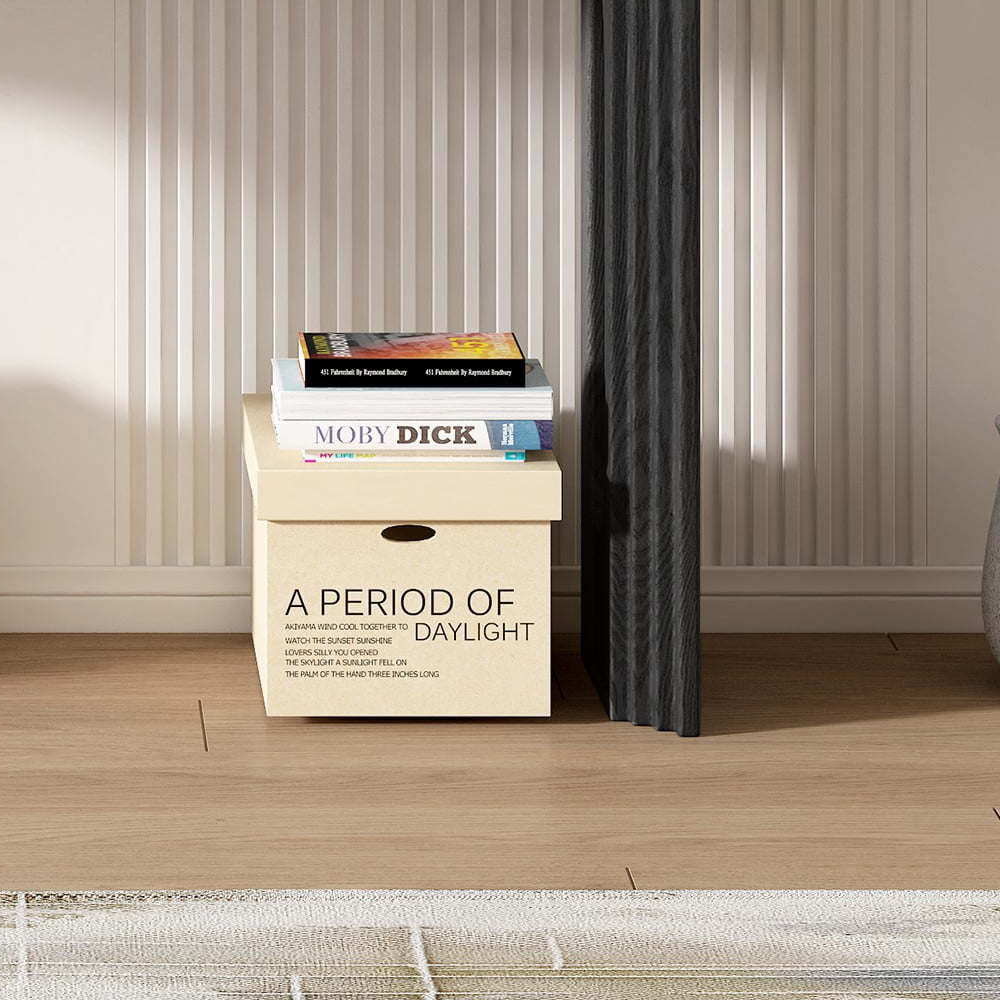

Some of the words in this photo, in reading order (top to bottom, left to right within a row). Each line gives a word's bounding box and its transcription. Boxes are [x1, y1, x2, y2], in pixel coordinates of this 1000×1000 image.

[320, 368, 330, 376] 451
[330, 368, 355, 376] Fahrenheit
[363, 368, 386, 377] Raymond
[386, 368, 408, 377] Bradbury
[425, 368, 434, 376] 451
[435, 368, 460, 376] Fahrenheit
[468, 368, 490, 377] Raymond
[491, 368, 512, 377] Bradbury
[314, 425, 391, 445] MOBY
[396, 425, 477, 445] DICK
[285, 588, 309, 616] A
[320, 588, 454, 616] PERIOD
[467, 588, 515, 616] OF
[284, 623, 316, 631] AKIYAMA
[317, 623, 338, 631] WIND
[339, 623, 359, 631] COOL
[360, 623, 397, 631] TOGETHER
[397, 623, 409, 631] TO
[414, 622, 535, 642] DAYLIGHT
[327, 637, 355, 645] SUNSET
[356, 637, 393, 645] SUNSHINE
[285, 670, 299, 678] THE
[300, 670, 319, 678] PALM
[319, 670, 330, 678] OF
[331, 670, 345, 678] THE
[346, 670, 367, 678] HAND
[367, 670, 391, 678] THREE
[391, 670, 419, 678] INCHES
[419, 670, 440, 678] LONG
